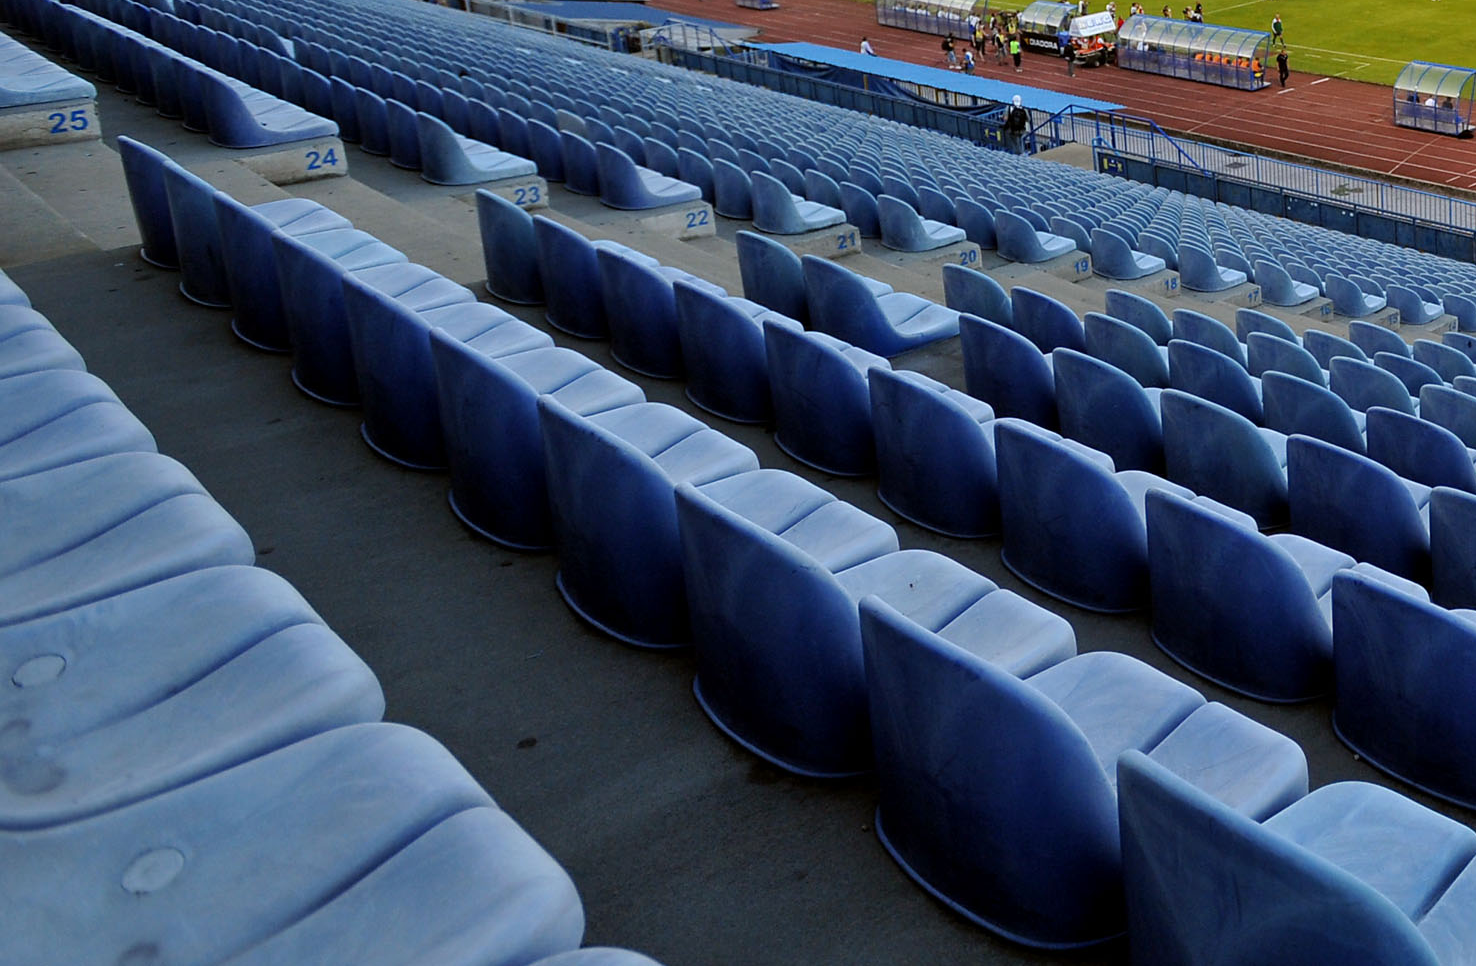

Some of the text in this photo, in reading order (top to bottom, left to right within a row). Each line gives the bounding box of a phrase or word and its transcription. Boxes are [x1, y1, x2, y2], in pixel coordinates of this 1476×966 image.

[1030, 38, 1058, 50] DIADORA
[48, 110, 88, 134] 25
[305, 148, 338, 170] 24
[514, 186, 540, 205] 23
[686, 210, 709, 228] 22
[837, 232, 856, 249] 21
[960, 250, 976, 266] 20
[1074, 260, 1088, 274] 19
[1164, 278, 1177, 290] 18
[1248, 290, 1259, 303] 17
